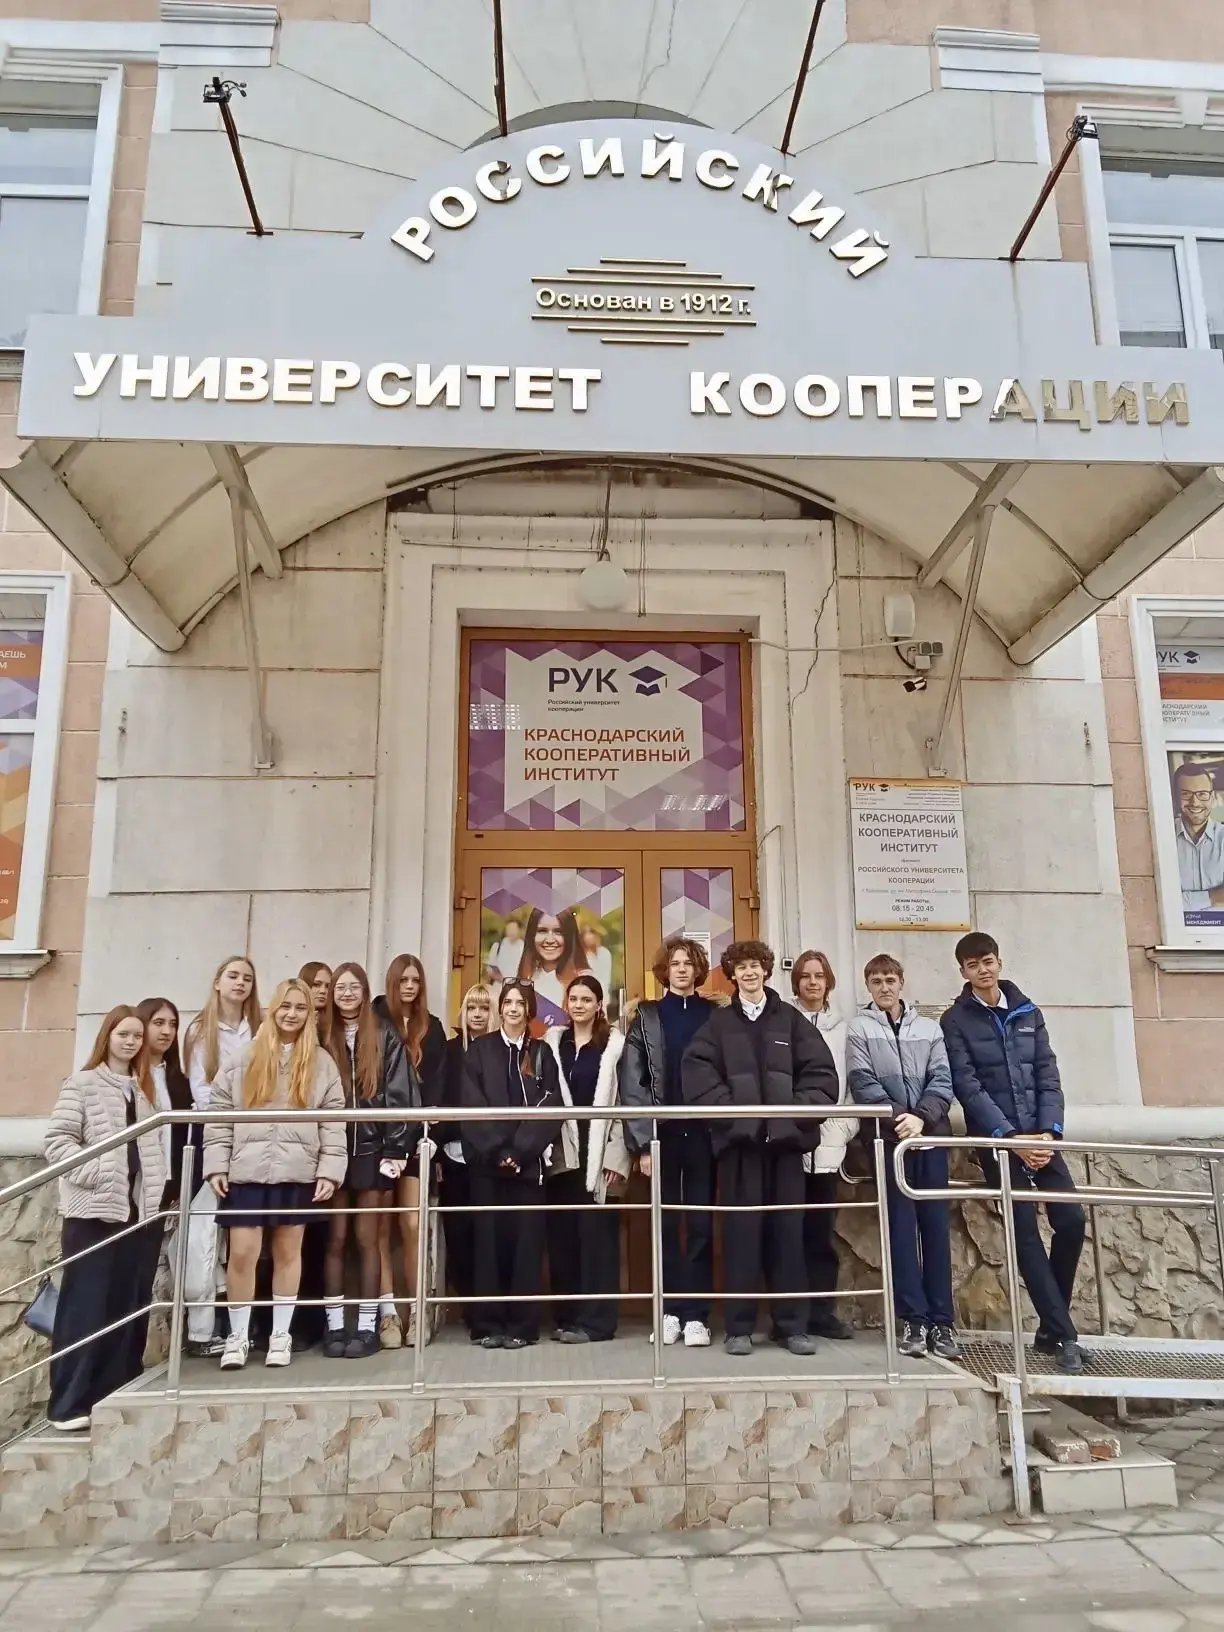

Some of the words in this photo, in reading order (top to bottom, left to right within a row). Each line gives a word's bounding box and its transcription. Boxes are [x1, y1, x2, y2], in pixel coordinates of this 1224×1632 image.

[390, 132, 890, 279] РОССИЙСКИЙ
[536, 287, 652, 312] Основан
[660, 296, 675, 312] в
[681, 292, 733, 314] 1912
[738, 299, 752, 315] г.
[72, 351, 602, 412] УНИВЕРСИТЕТ
[690, 371, 1191, 431] КООПЕРАЦИИ
[1156, 651, 1180, 663] УК
[548, 667, 619, 693] РУК
[524, 727, 685, 744] КРАСНОДАРСКИЙ
[524, 746, 691, 762] КООПЕРАТИВНЫЙ
[524, 768, 620, 781] ИНСТИТУТ
[855, 783, 876, 791] РУК
[859, 813, 956, 824] КРАСНОДАРСКИЙ
[858, 828, 959, 838] КООПЕРАТИВНЫЙ
[880, 843, 938, 852] ИНСТИТУТ
[857, 865, 910, 873] РОССИЙСКОГО
[911, 866, 964, 874] УНИВЕРСИТЕТА
